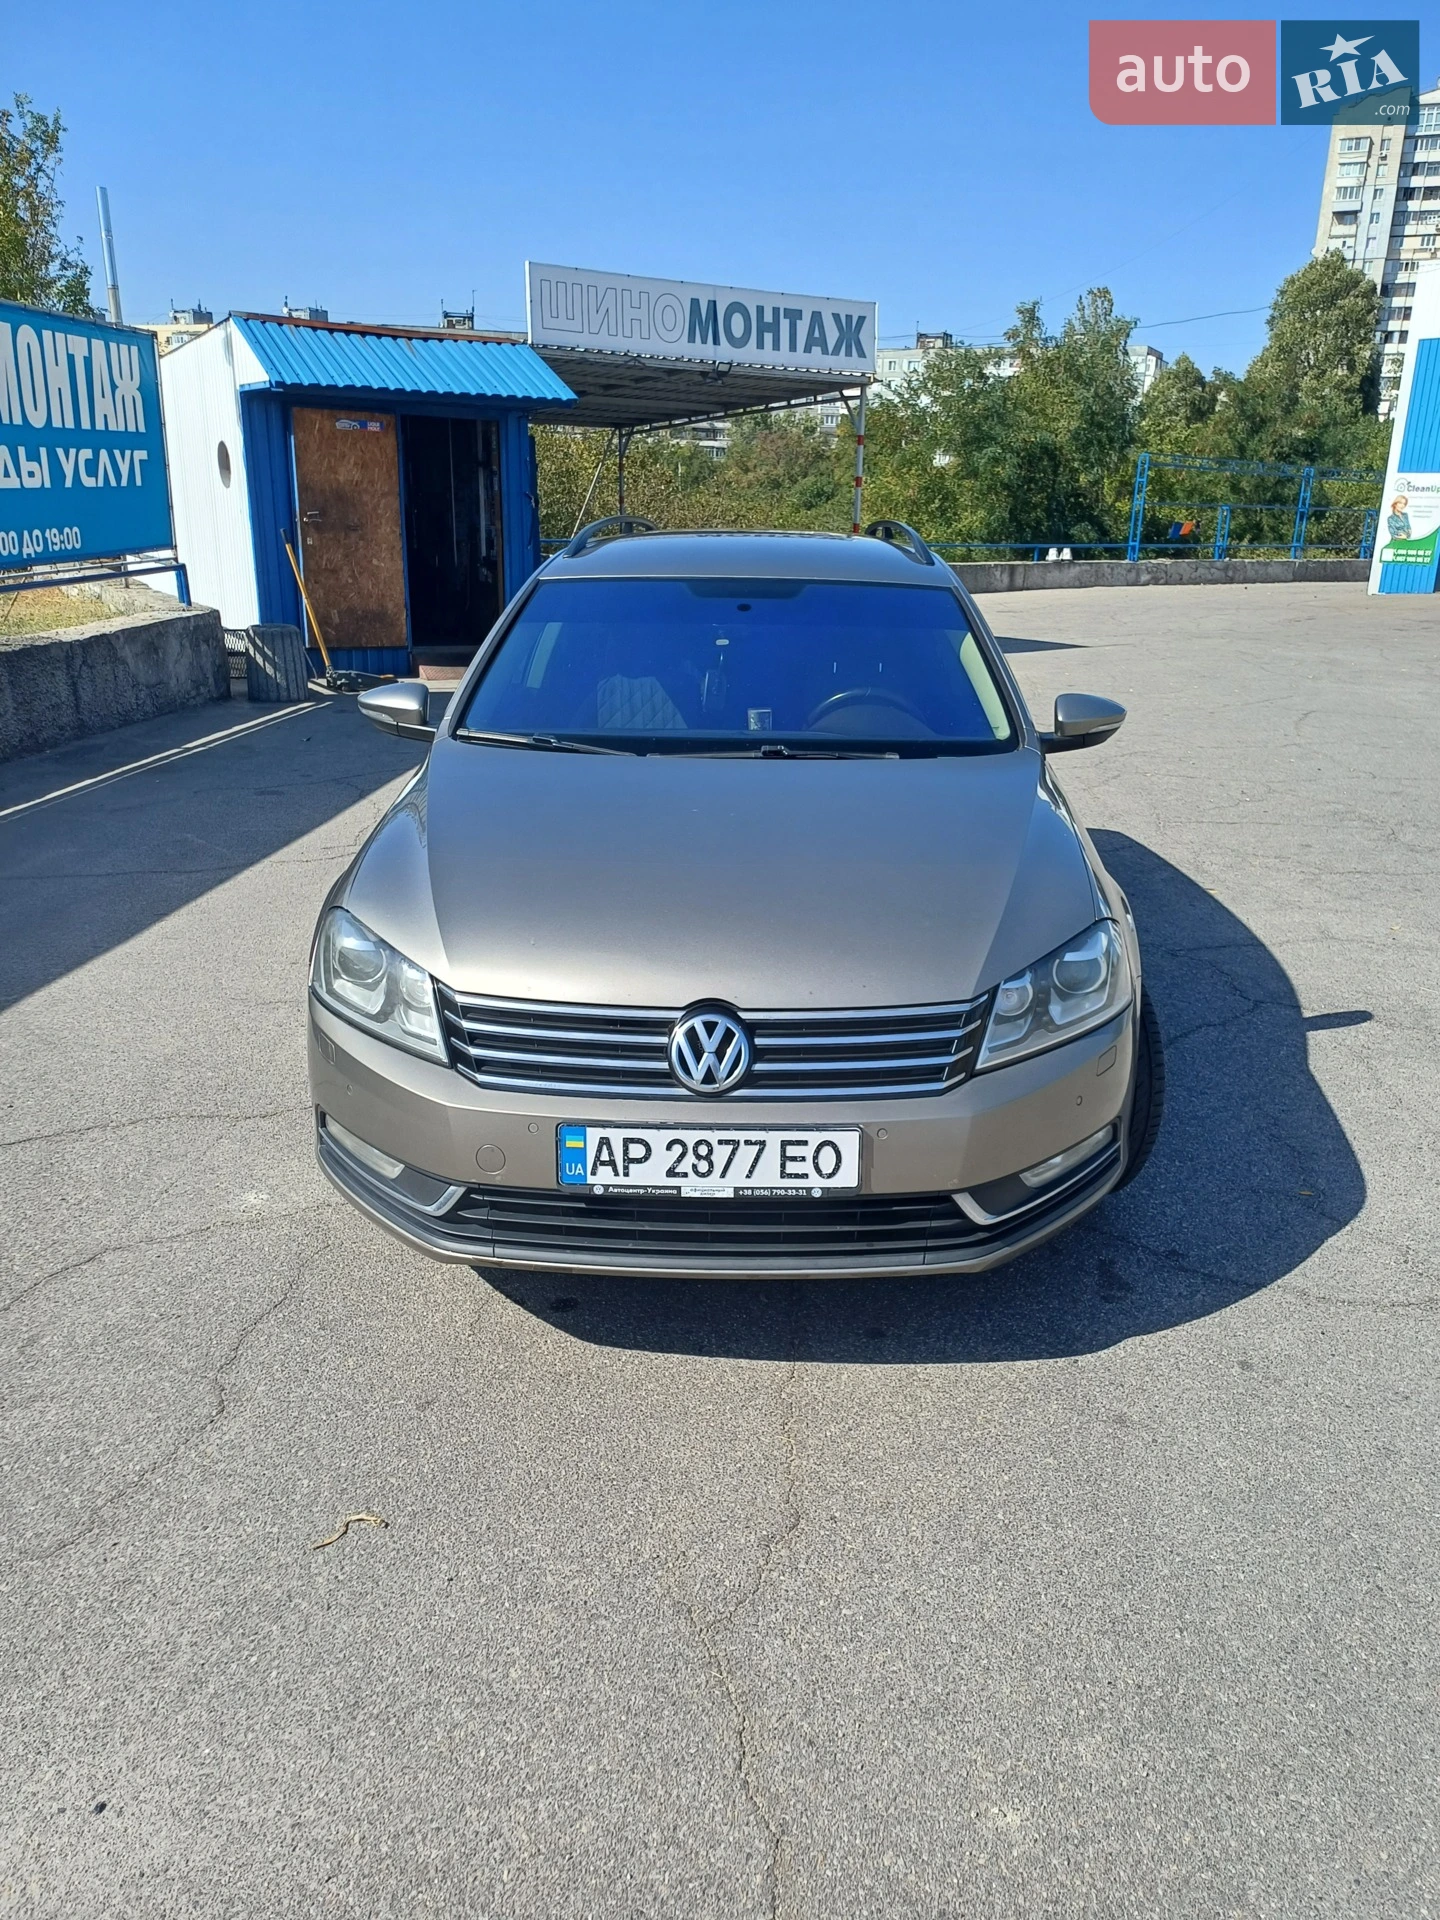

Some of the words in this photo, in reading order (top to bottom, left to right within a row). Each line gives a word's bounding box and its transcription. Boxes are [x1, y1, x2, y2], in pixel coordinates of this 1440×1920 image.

[540, 279, 867, 359] ШИНОМОНТАЖ
[55, 447, 149, 488] УСЛУГ
[22, 529, 44, 559] ДО
[45, 526, 82, 552] 19:00
[565, 1162, 585, 1176] UA
[590, 1136, 652, 1177] AP
[665, 1138, 767, 1179] 2877
[779, 1139, 842, 1179] EO
